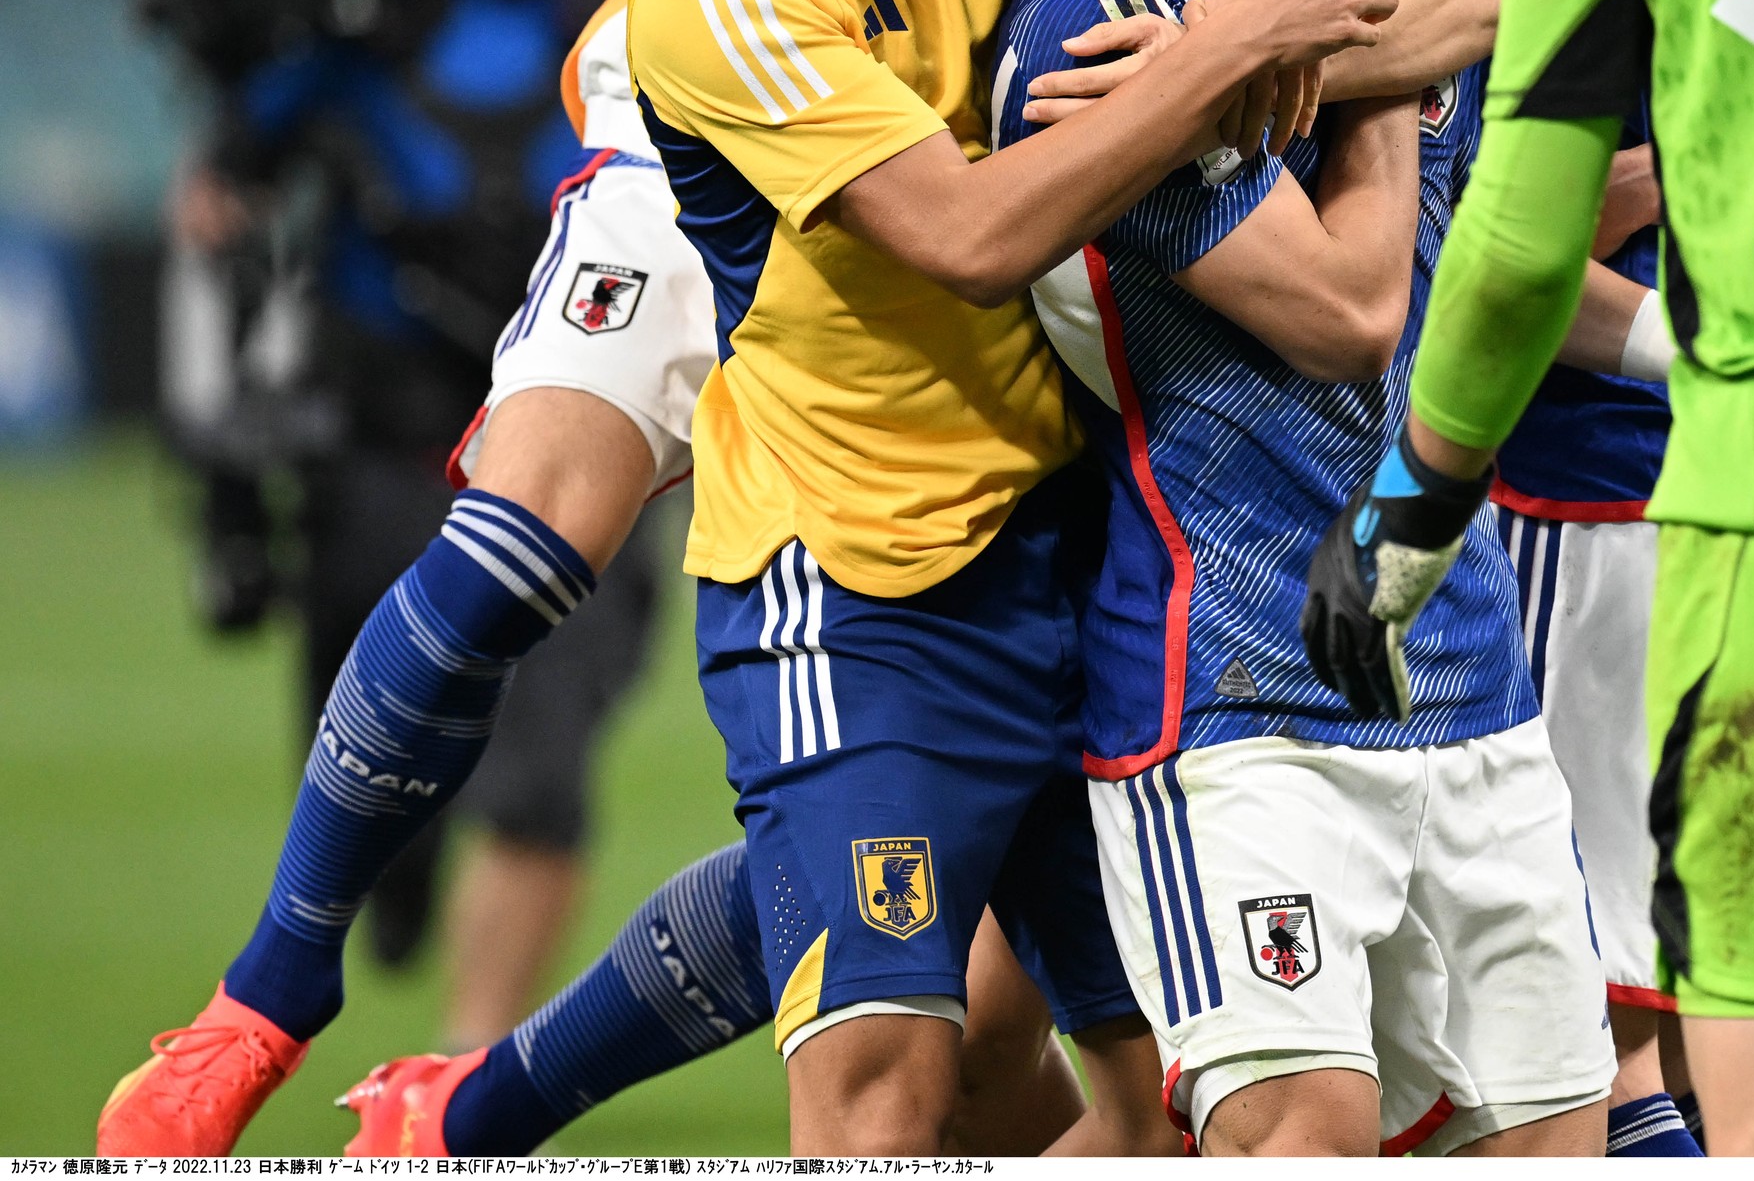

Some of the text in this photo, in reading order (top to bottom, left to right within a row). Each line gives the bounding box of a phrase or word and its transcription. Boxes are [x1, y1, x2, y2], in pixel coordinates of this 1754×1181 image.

[593, 264, 634, 278] JAPAN
[873, 842, 912, 852] JAPAN
[1256, 897, 1296, 909] JAPAN
[883, 905, 917, 922] JFA
[1271, 959, 1305, 976] JFA
